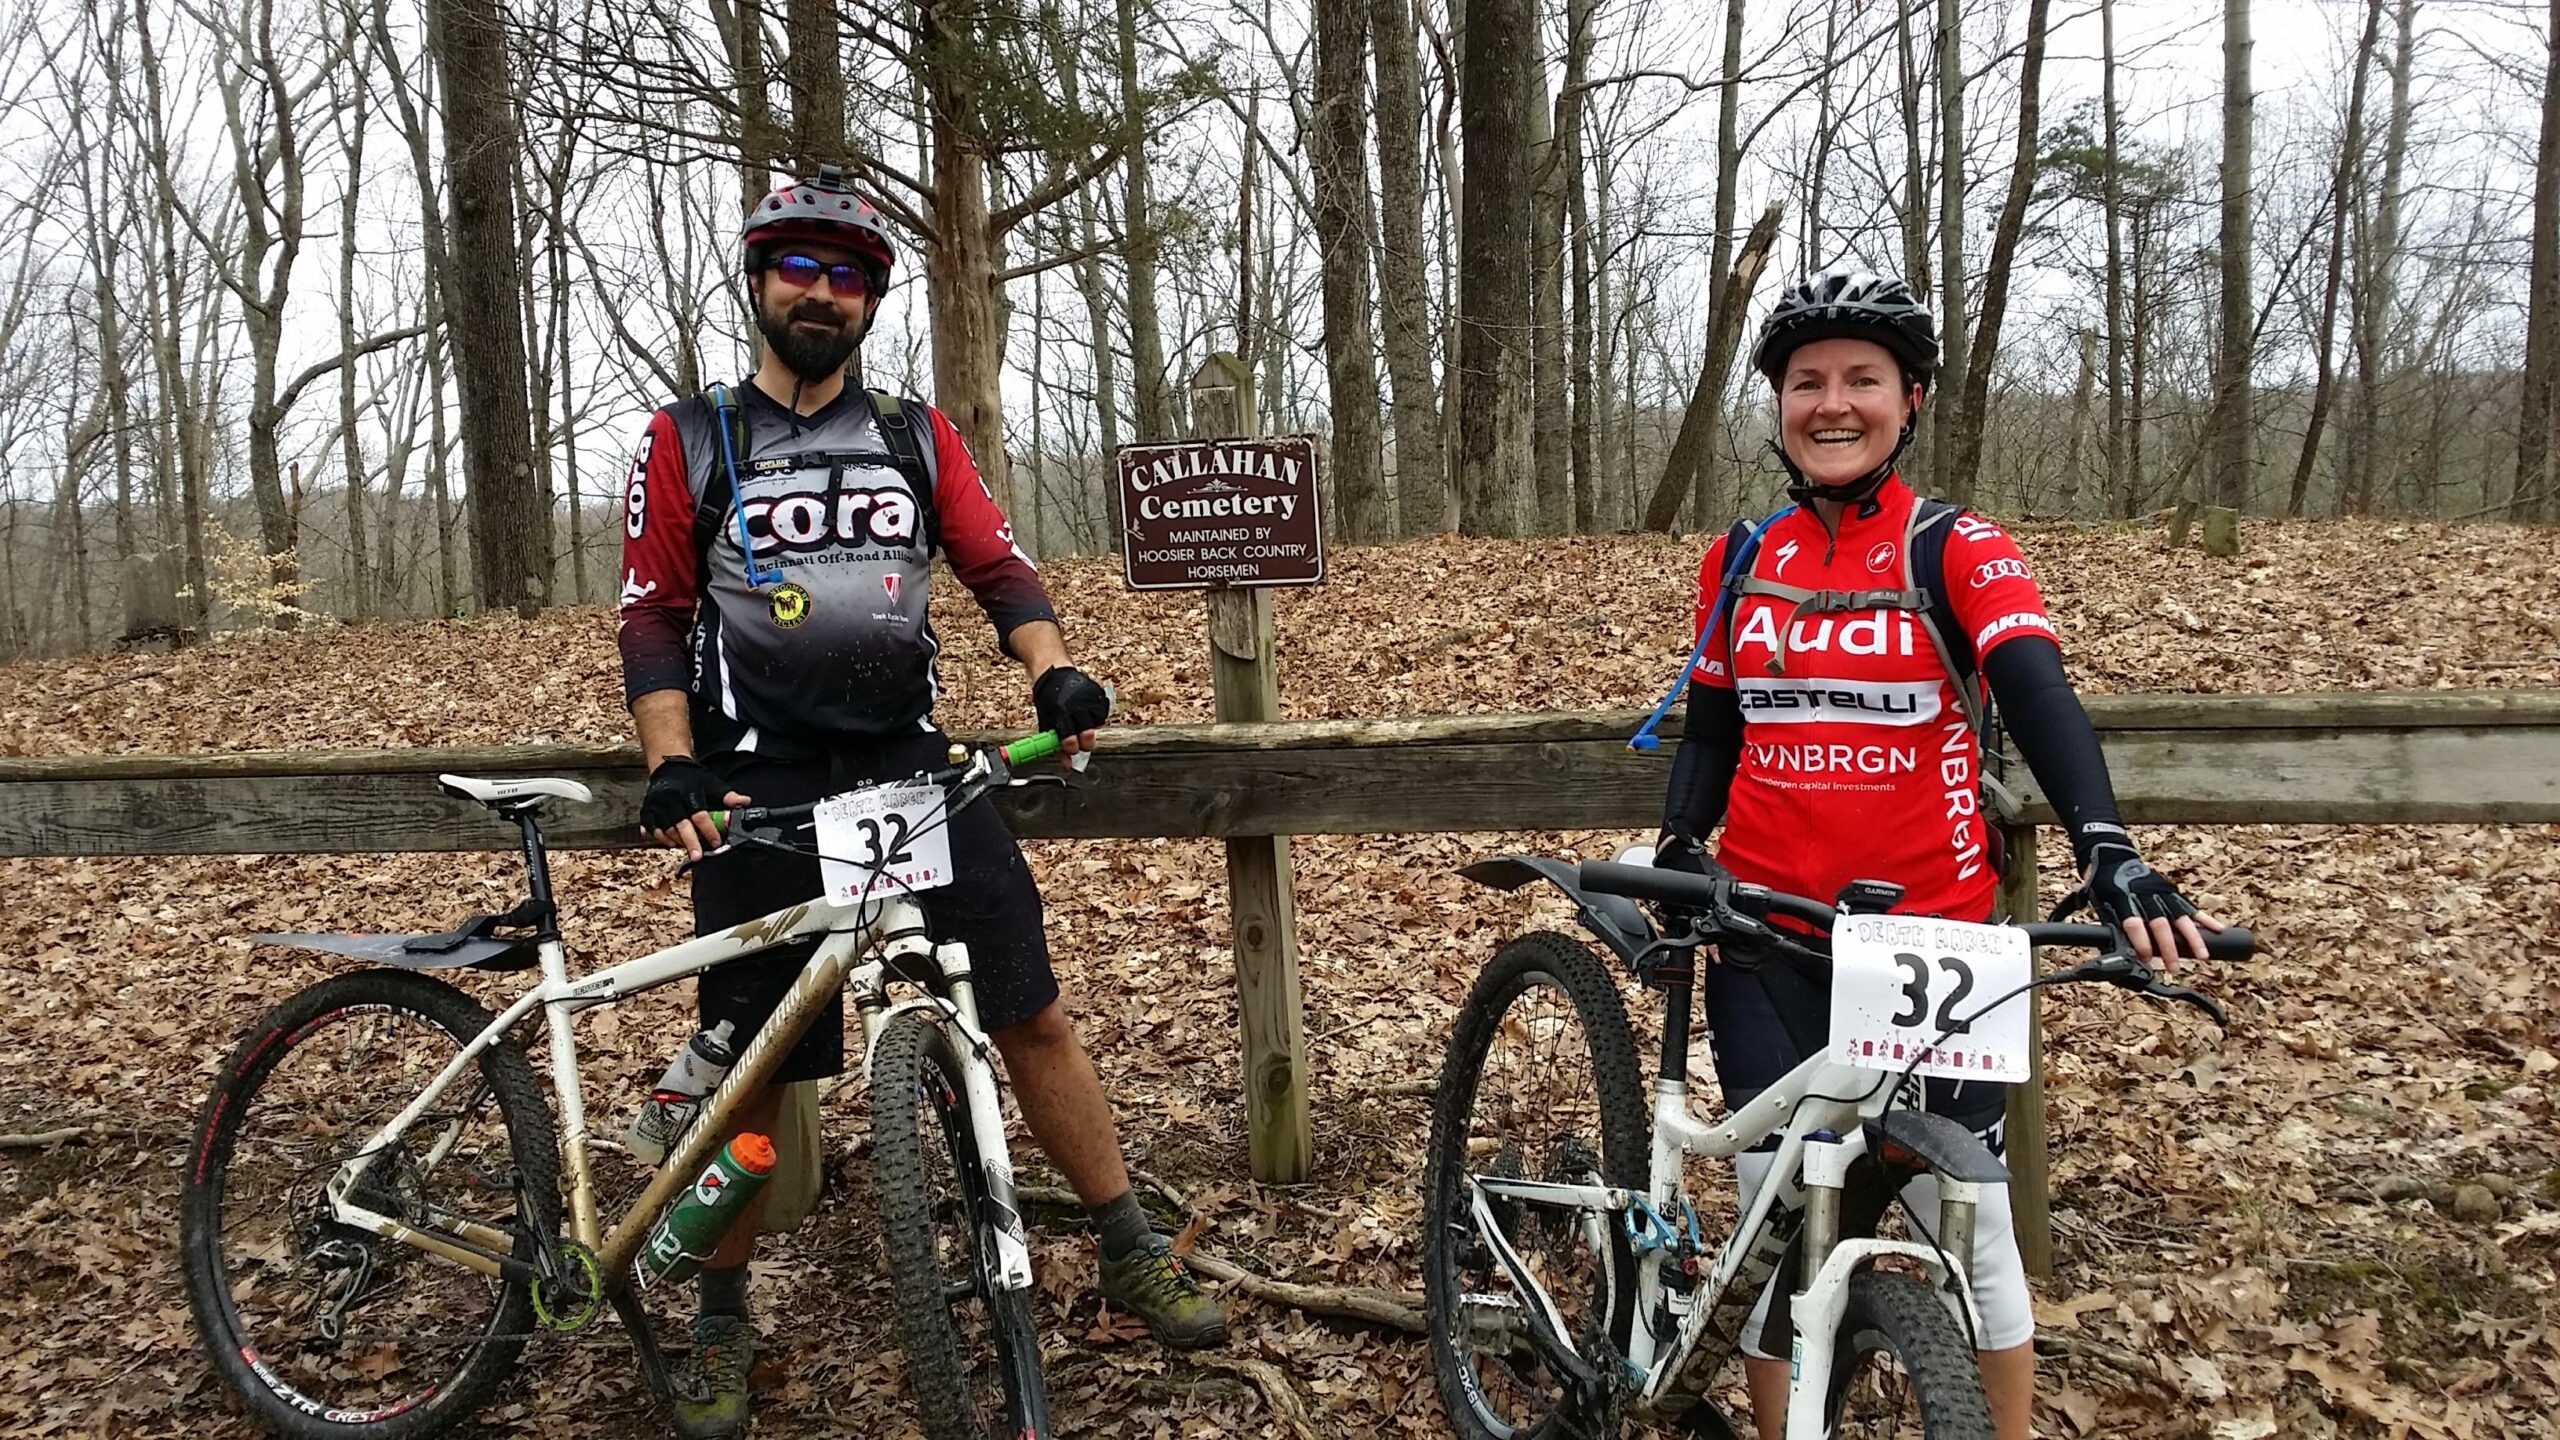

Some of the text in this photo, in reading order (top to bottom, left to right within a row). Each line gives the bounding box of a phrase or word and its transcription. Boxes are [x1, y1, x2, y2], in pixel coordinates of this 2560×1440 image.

[626, 434, 654, 539] cora
[1131, 449, 1302, 492] CALLAHAN
[727, 491, 916, 551] cora
[1140, 493, 1298, 520] Cemetery
[1138, 544, 1307, 563] HOOSIER BACK COUNTRY
[1169, 527, 1271, 544] MAINTAINED BY
[818, 552, 880, 564] Off-Road
[1188, 564, 1260, 578] HORSEMEN
[1735, 606, 1914, 656] Audi
[1799, 782, 1830, 792] capital
[1833, 782, 1895, 792] investments
[856, 813, 912, 869] 32
[1864, 887, 1896, 897] GARMIN
[1858, 921, 2001, 955] DEATH MARCH
[1891, 953, 1974, 1034] 32
[669, 980, 801, 1172] ROCKY MOUNTAIN
[272, 1384, 320, 1415] ZTR
[324, 1410, 382, 1423] CREST
